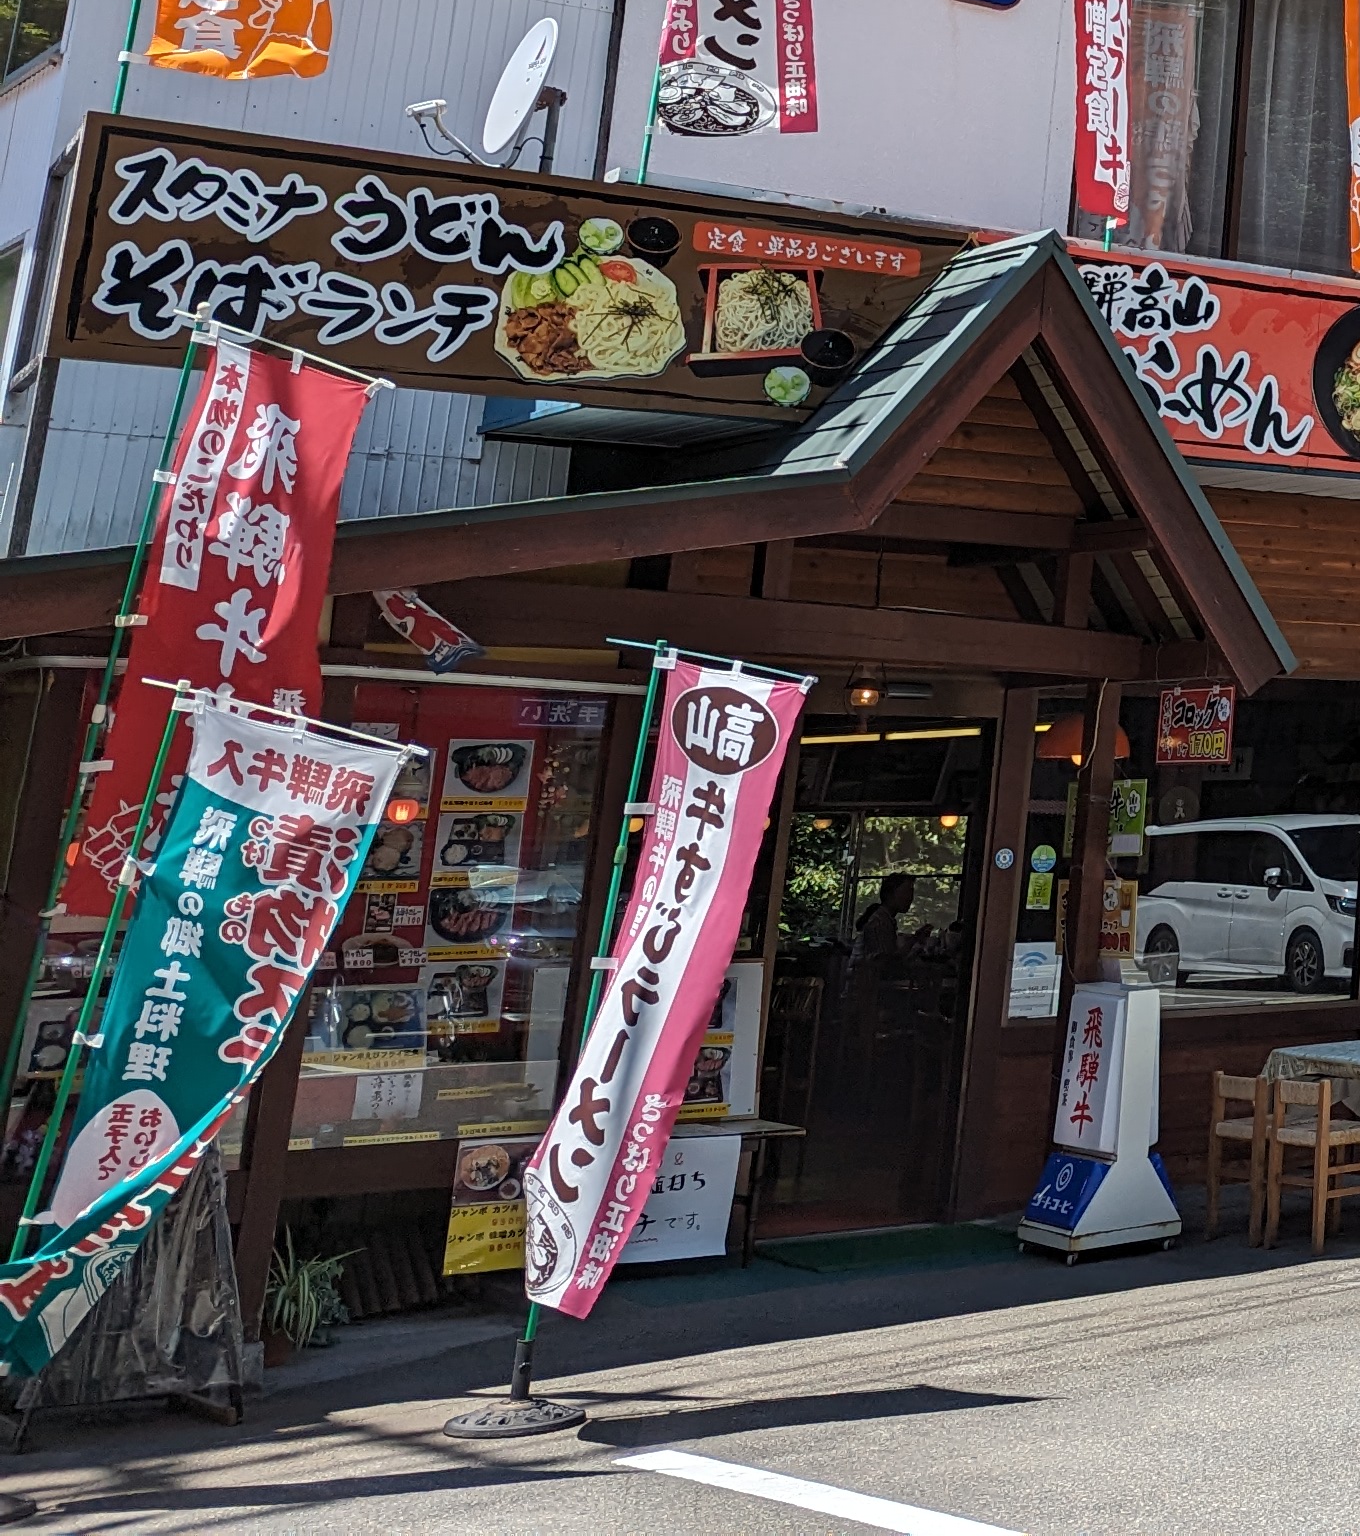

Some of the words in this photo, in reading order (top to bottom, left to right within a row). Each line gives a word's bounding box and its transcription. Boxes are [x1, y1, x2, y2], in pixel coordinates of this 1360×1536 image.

[98, 244, 494, 358] そばランチ
[1171, 691, 1220, 731] コロッケ
[1189, 729, 1226, 759] 170円
[1069, 1006, 1104, 1139] 飛騨牛
